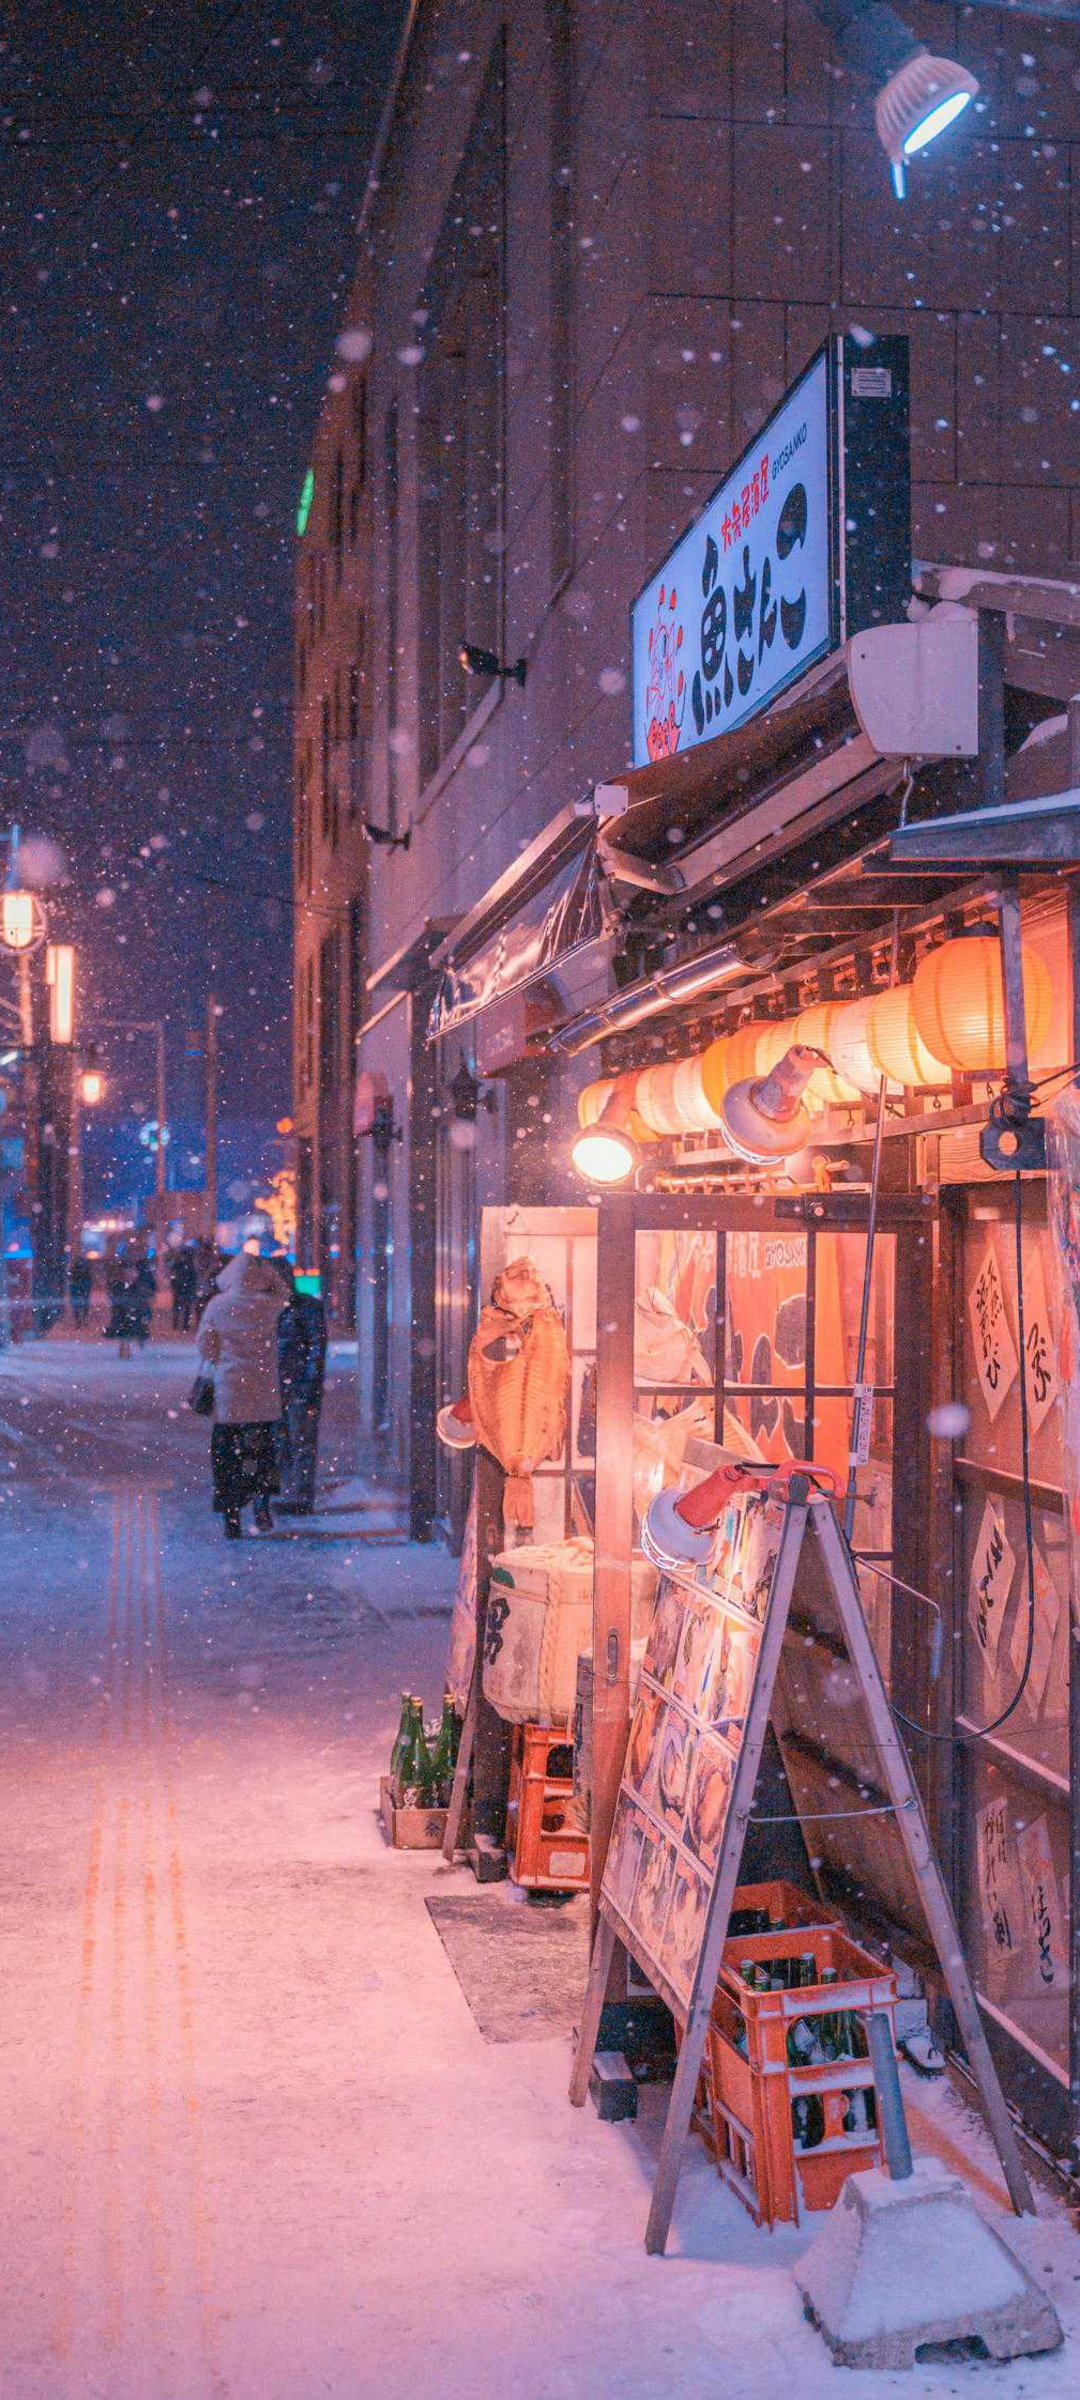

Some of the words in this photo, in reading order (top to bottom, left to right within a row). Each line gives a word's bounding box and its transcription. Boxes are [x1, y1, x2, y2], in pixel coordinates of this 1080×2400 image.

[772, 422, 807, 480] GYOSANKO
[692, 483, 807, 736] 魚さんこ
